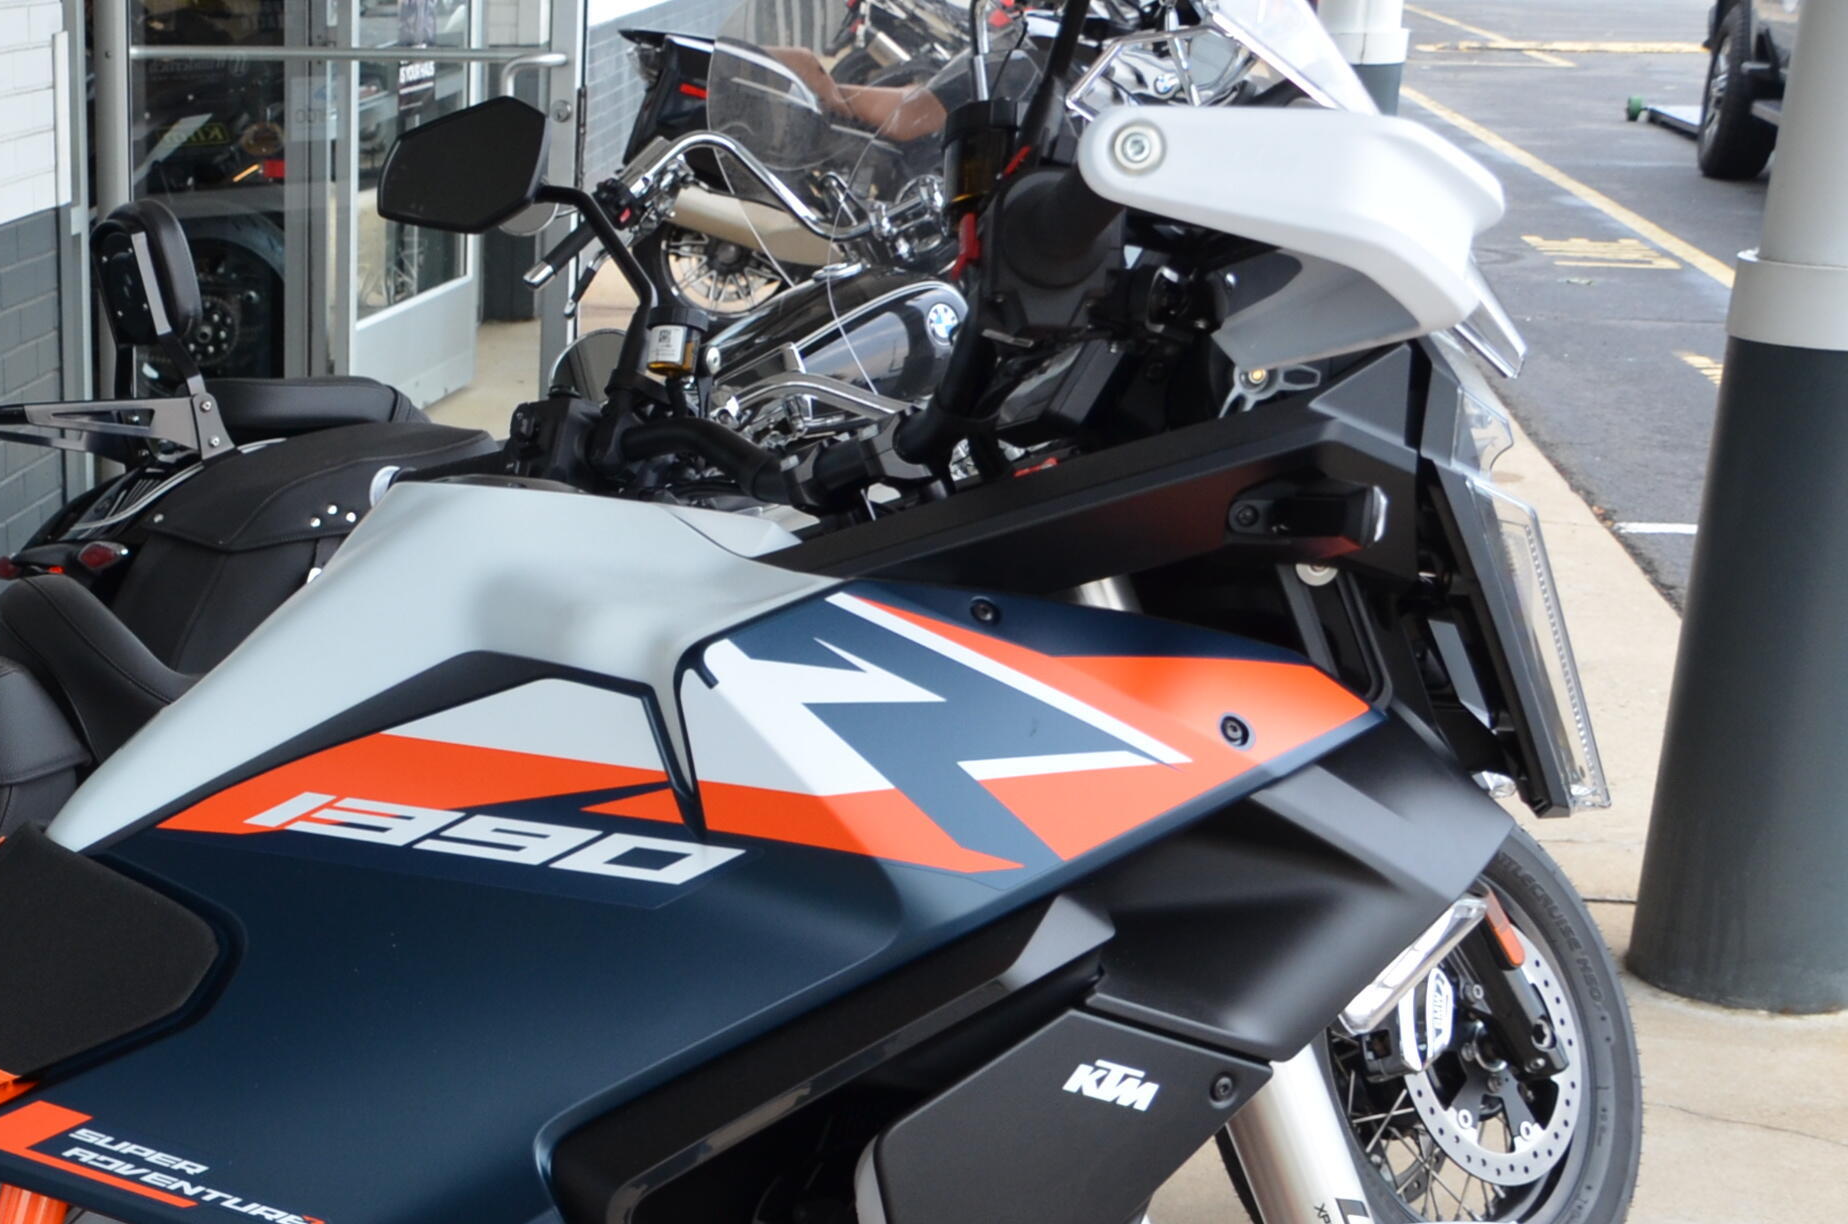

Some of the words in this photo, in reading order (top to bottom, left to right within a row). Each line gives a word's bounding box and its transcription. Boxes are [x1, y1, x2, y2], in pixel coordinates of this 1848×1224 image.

[243, 791, 747, 885] 1390
[1062, 1059, 1160, 1112] KTM
[69, 1128, 209, 1175] SUPER
